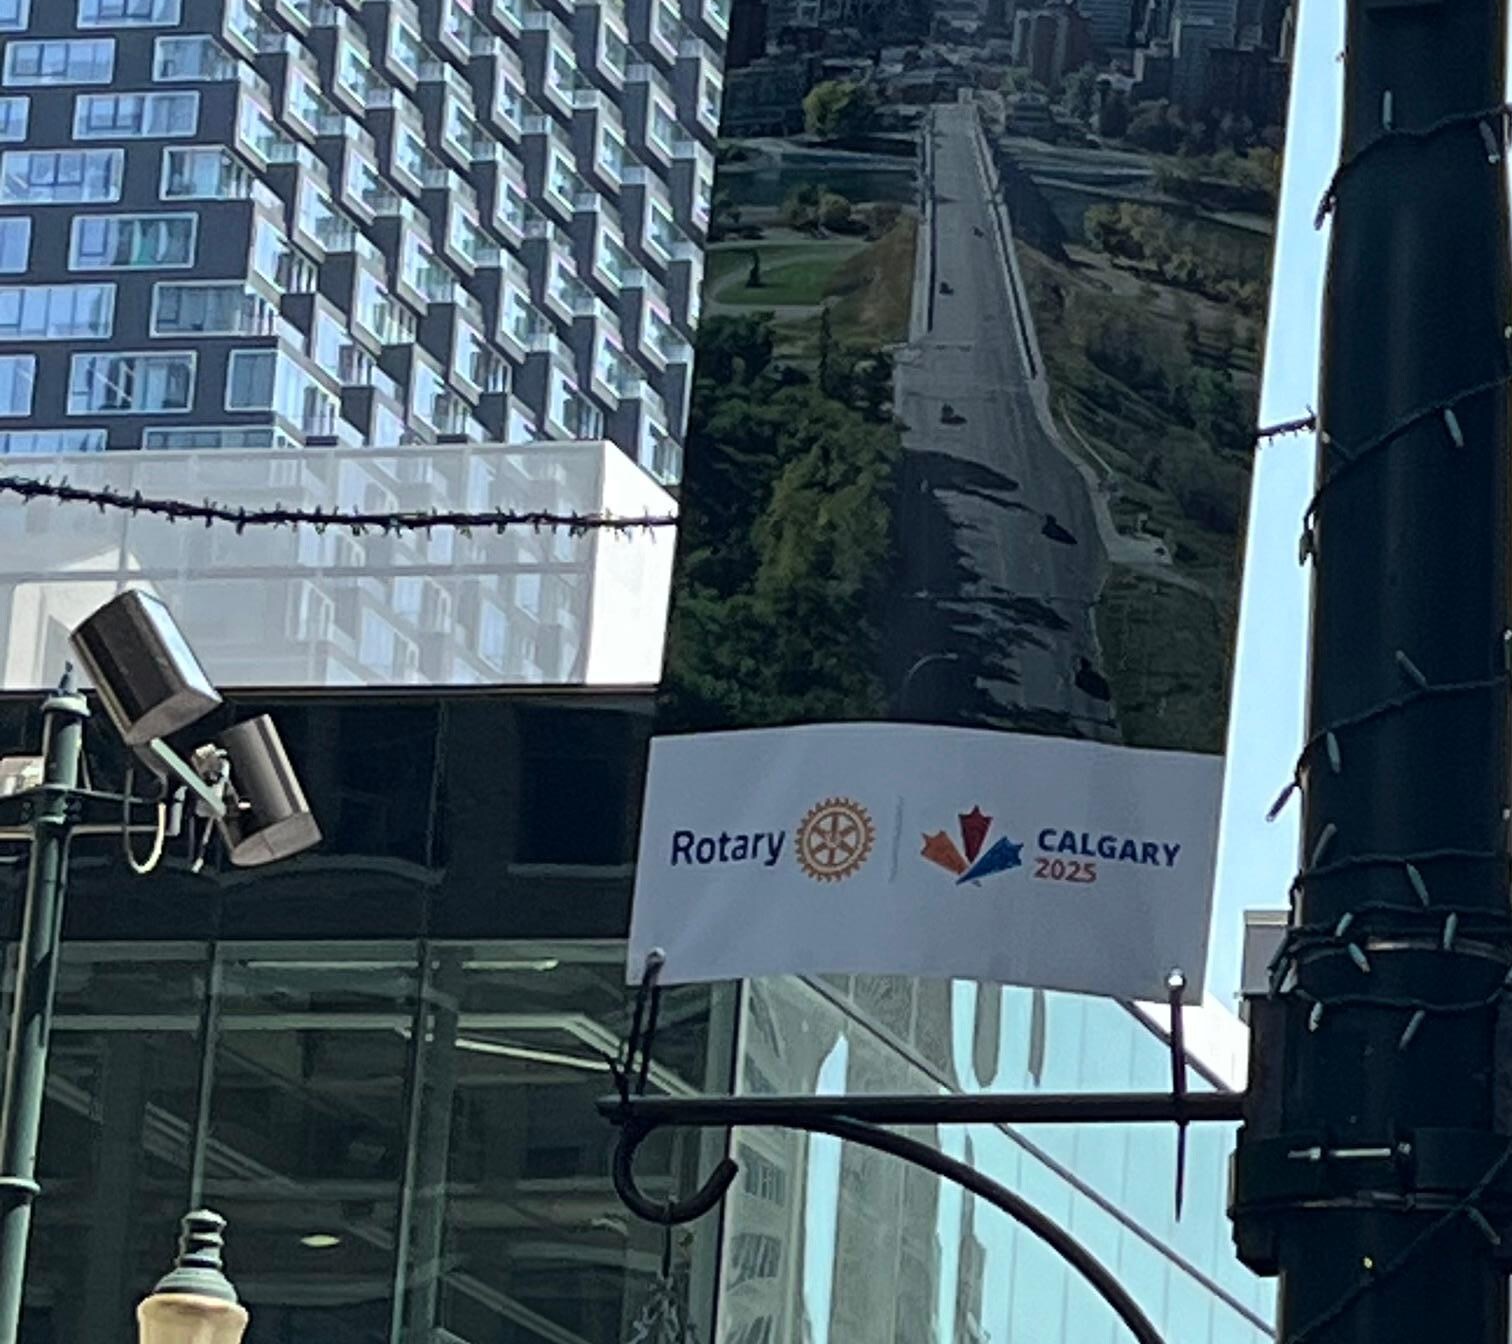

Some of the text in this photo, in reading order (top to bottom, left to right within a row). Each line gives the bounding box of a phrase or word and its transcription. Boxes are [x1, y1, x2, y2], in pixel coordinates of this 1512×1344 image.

[670, 829, 787, 867] Rotary
[1037, 827, 1182, 867] CALGARY
[1033, 857, 1098, 884] 2025
